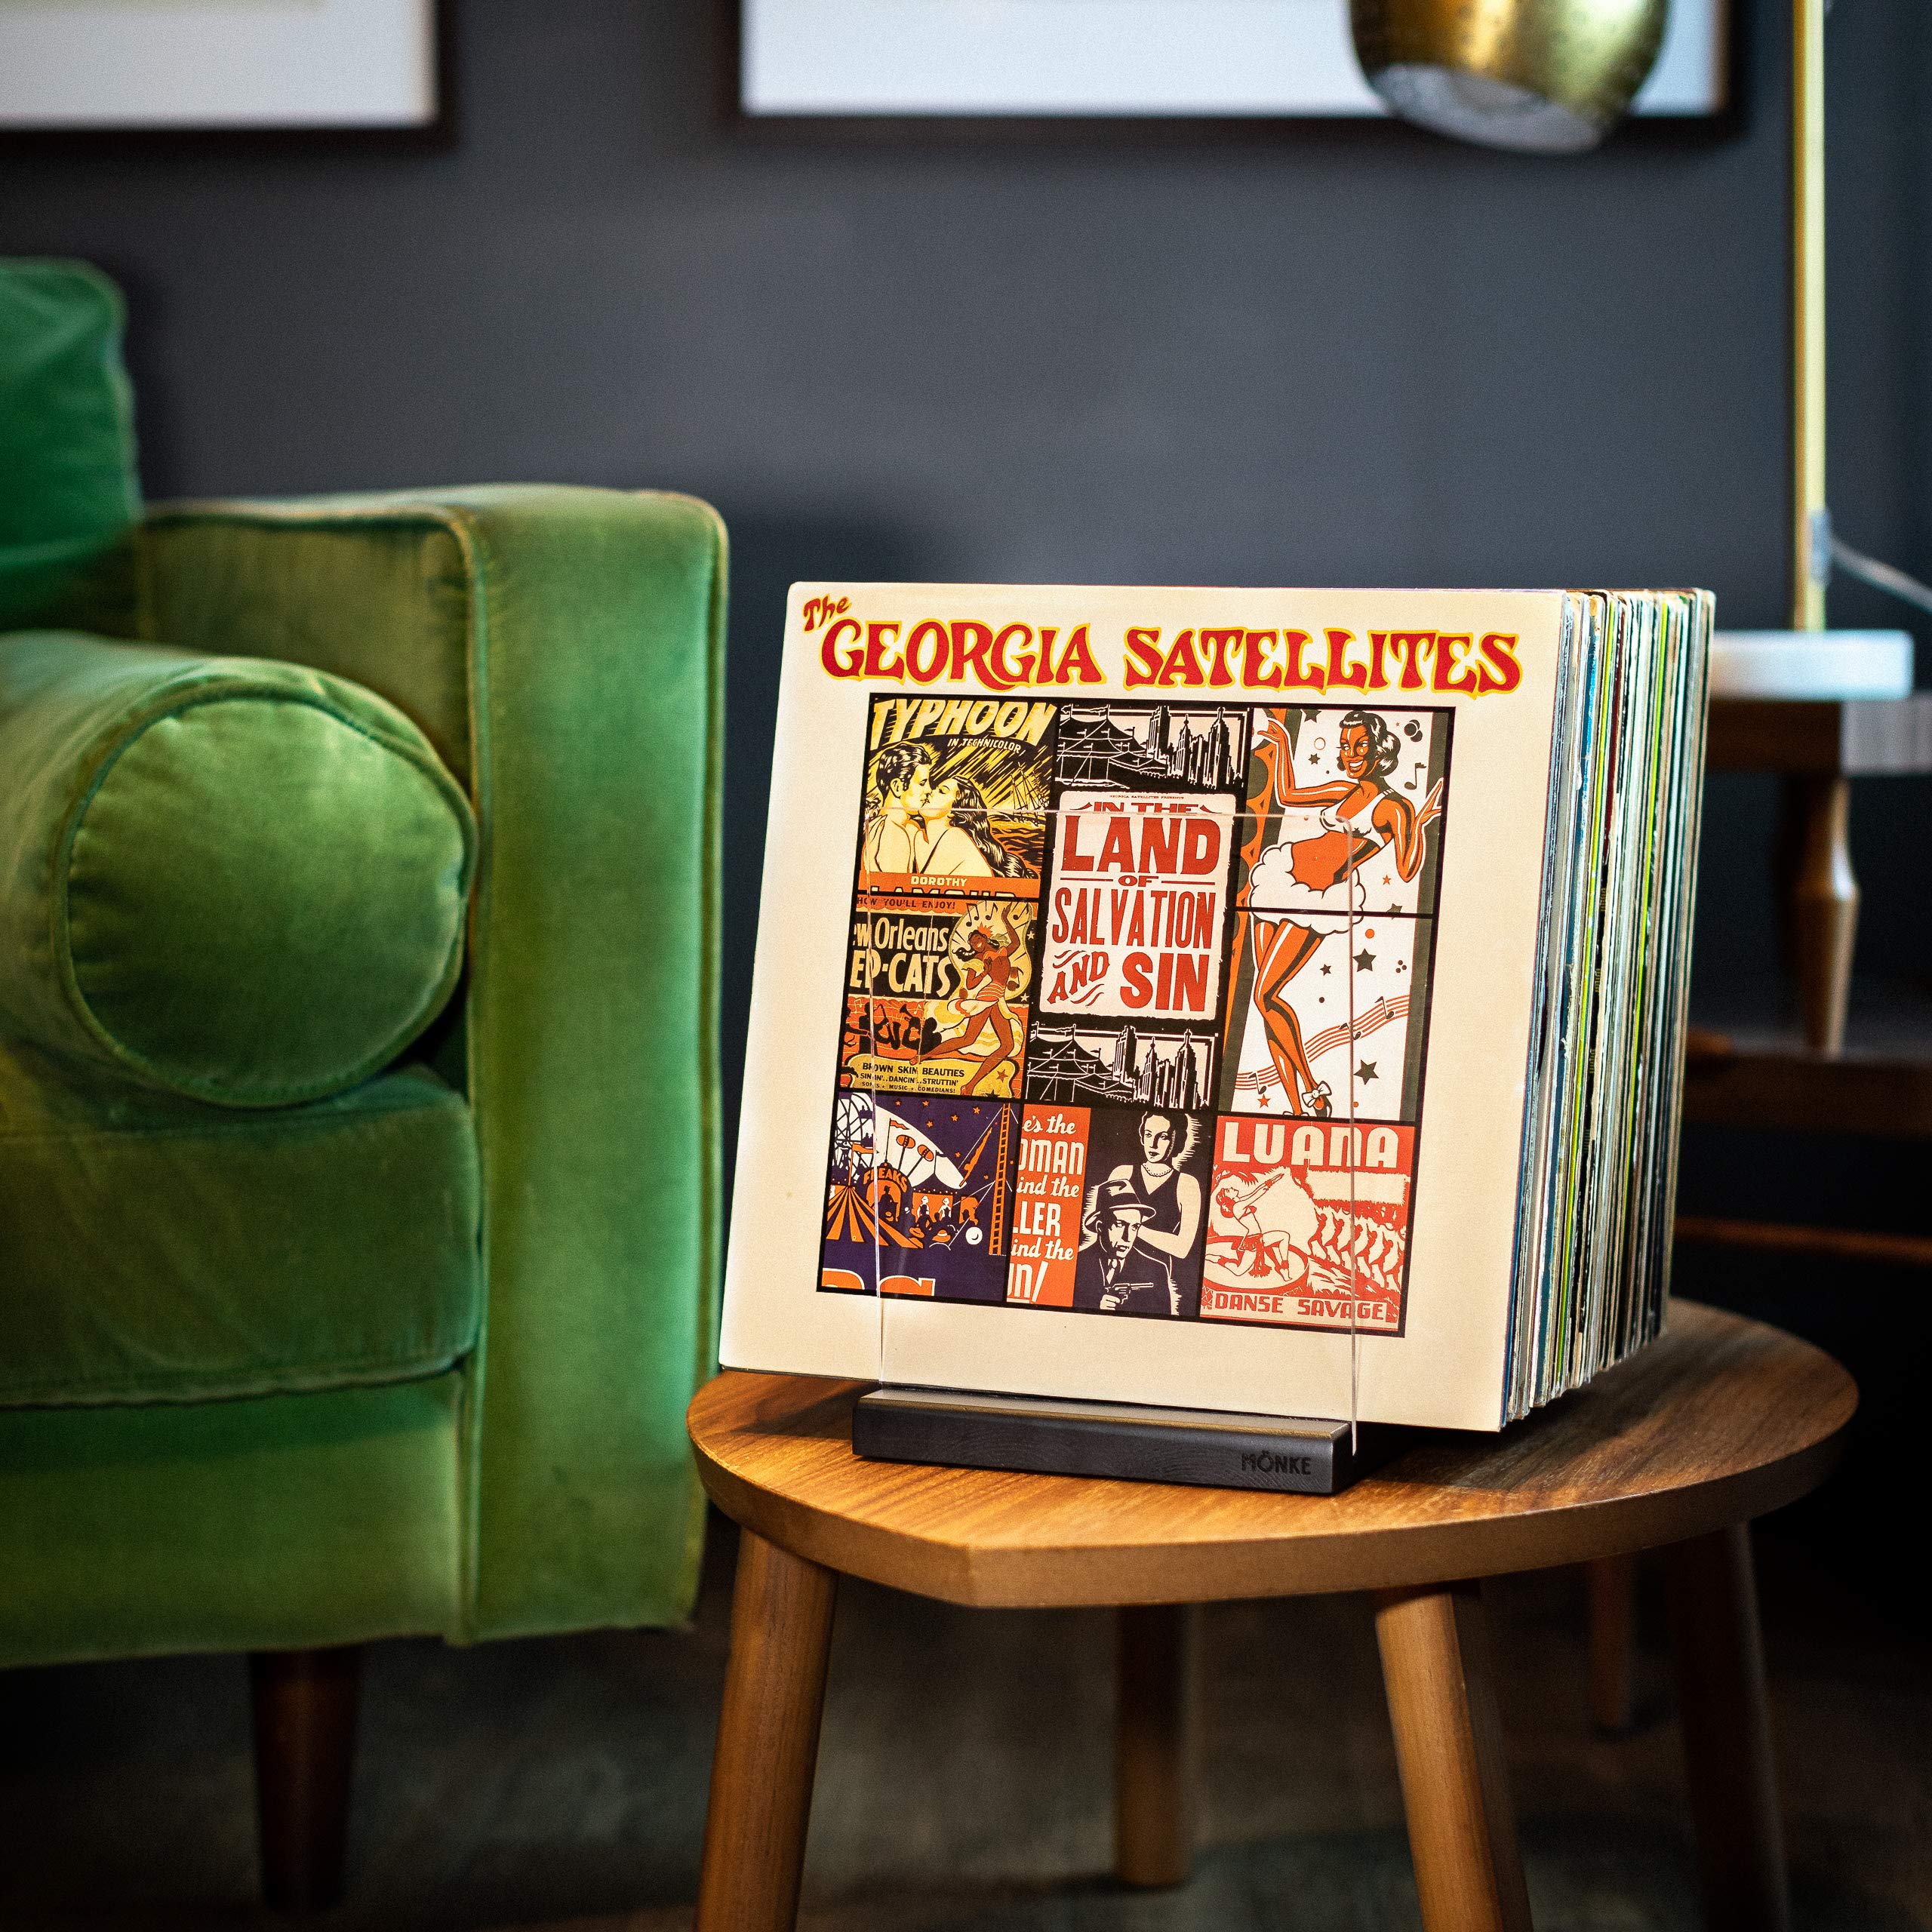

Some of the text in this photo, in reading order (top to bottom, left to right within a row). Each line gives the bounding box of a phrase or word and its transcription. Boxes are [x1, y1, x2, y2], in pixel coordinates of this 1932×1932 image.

[803, 594, 851, 632] The
[820, 617, 1523, 700] GEORGIA SATELLITES
[870, 698, 1057, 751] TYPHOON
[947, 738, 1022, 754] IN TECHNICOLOR
[1094, 801, 1198, 815] IN THE
[1060, 815, 1221, 875] LAND
[910, 875, 968, 888] DOROTHY
[1118, 875, 1159, 888] OF
[884, 898, 917, 908] YOU'LL
[922, 900, 955, 909] ENJOY!
[1052, 887, 1216, 949] SALVATION
[875, 917, 949, 952] Orleans
[1047, 951, 1210, 1012] AND SIN
[898, 1066, 918, 1075] SKIN
[922, 1067, 965, 1078] BEAUTIES
[1045, 1113, 1076, 1135] the
[1223, 1121, 1399, 1168] LUANA
[1016, 1174, 1080, 1198] ind the
[1013, 1201, 1061, 1237] LER
[1011, 1237, 1074, 1261] ind the
[1214, 1292, 1384, 1321] DANSE SAVAGE
[1241, 1450, 1311, 1475] MÖNKE
